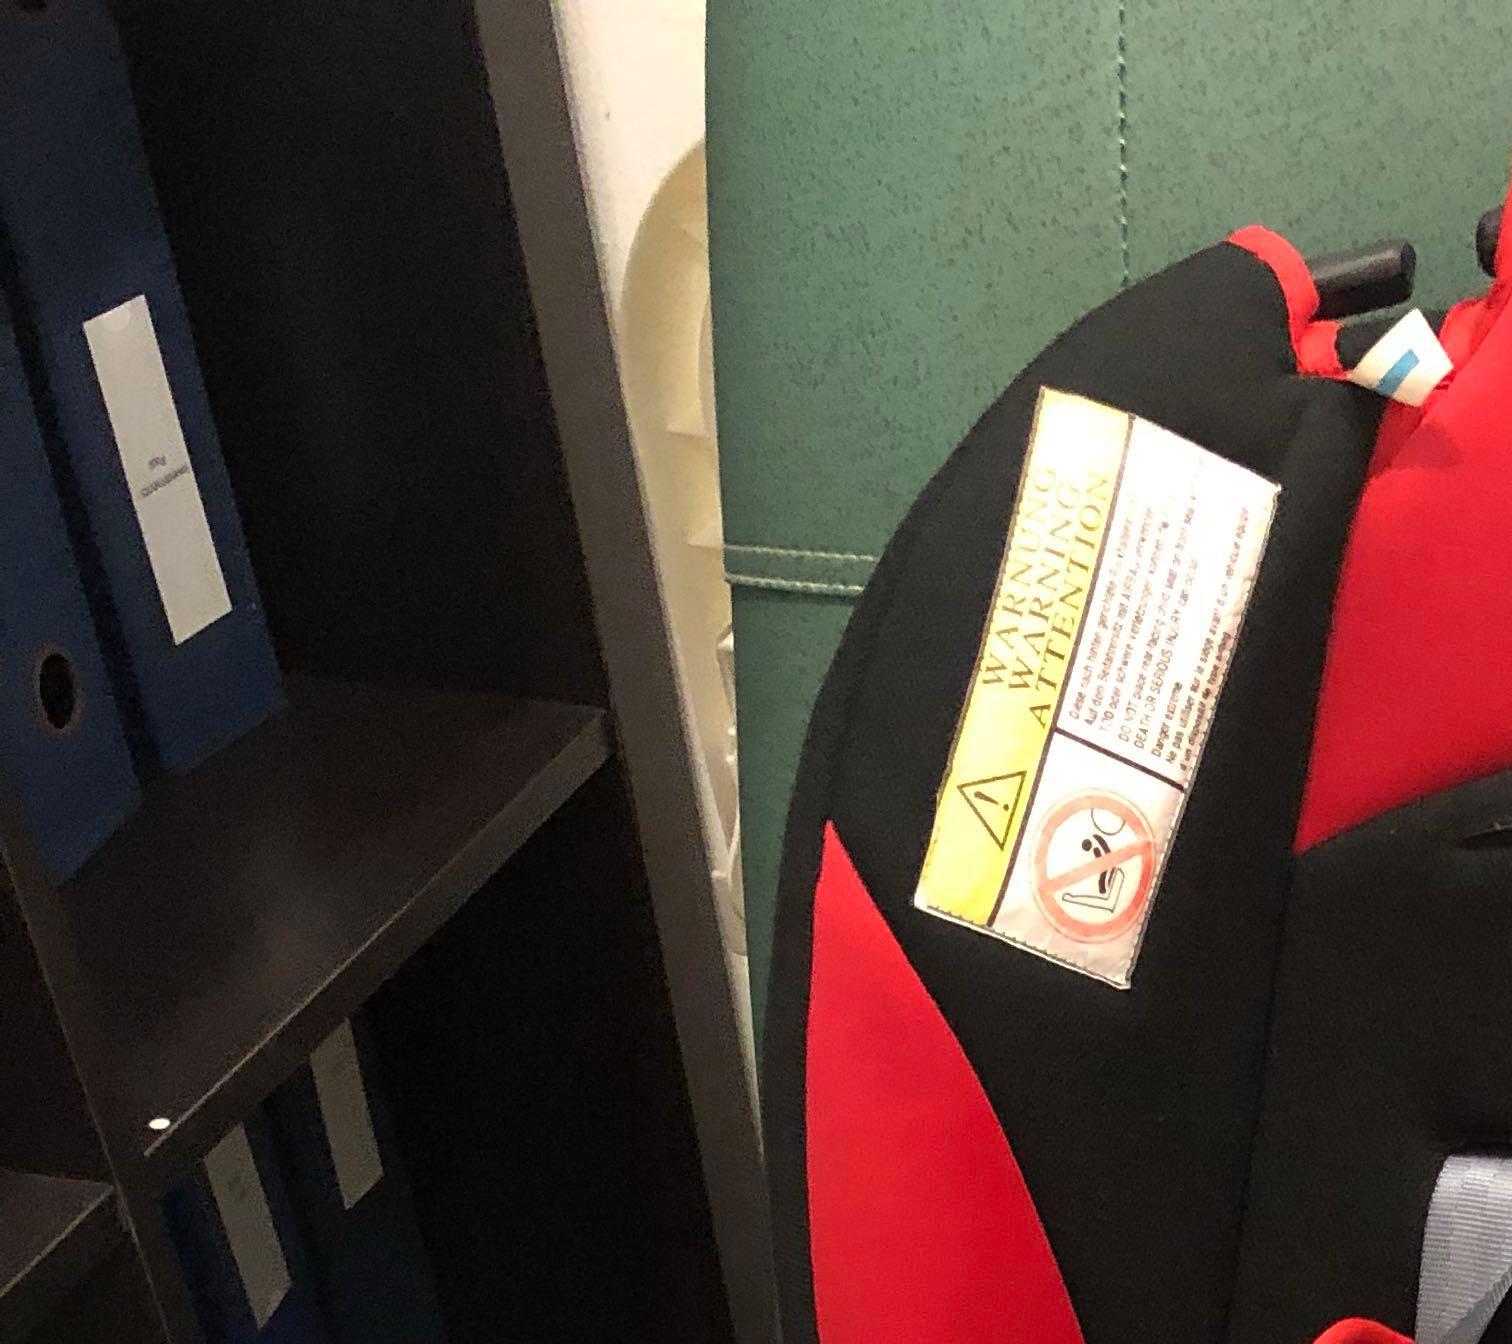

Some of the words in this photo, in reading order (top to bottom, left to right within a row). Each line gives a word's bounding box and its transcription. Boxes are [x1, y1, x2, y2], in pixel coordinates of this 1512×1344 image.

[981, 463, 1058, 691] WARNUNG
[1006, 479, 1082, 697] WARNING
[1025, 470, 1112, 729] ATTENTION
[1078, 663, 1093, 689] nach
[1086, 630, 1102, 662] hinten
[1114, 641, 1134, 684] schwere
[1149, 646, 1172, 695] SERIOUS
[1131, 671, 1148, 700] place
[1143, 694, 1157, 712] OR
[1189, 676, 1201, 694] sur
[1083, 706, 1099, 727] Auf
[1091, 683, 1105, 707] dem
[1122, 700, 1139, 724] NOT
[1176, 693, 1195, 728] utiliser
[1117, 723, 1132, 742] DO
[1133, 712, 1152, 749] DEATH
[1150, 720, 1172, 759] Danger
[1171, 729, 1186, 750] pas
[1164, 749, 1178, 765] Ne
